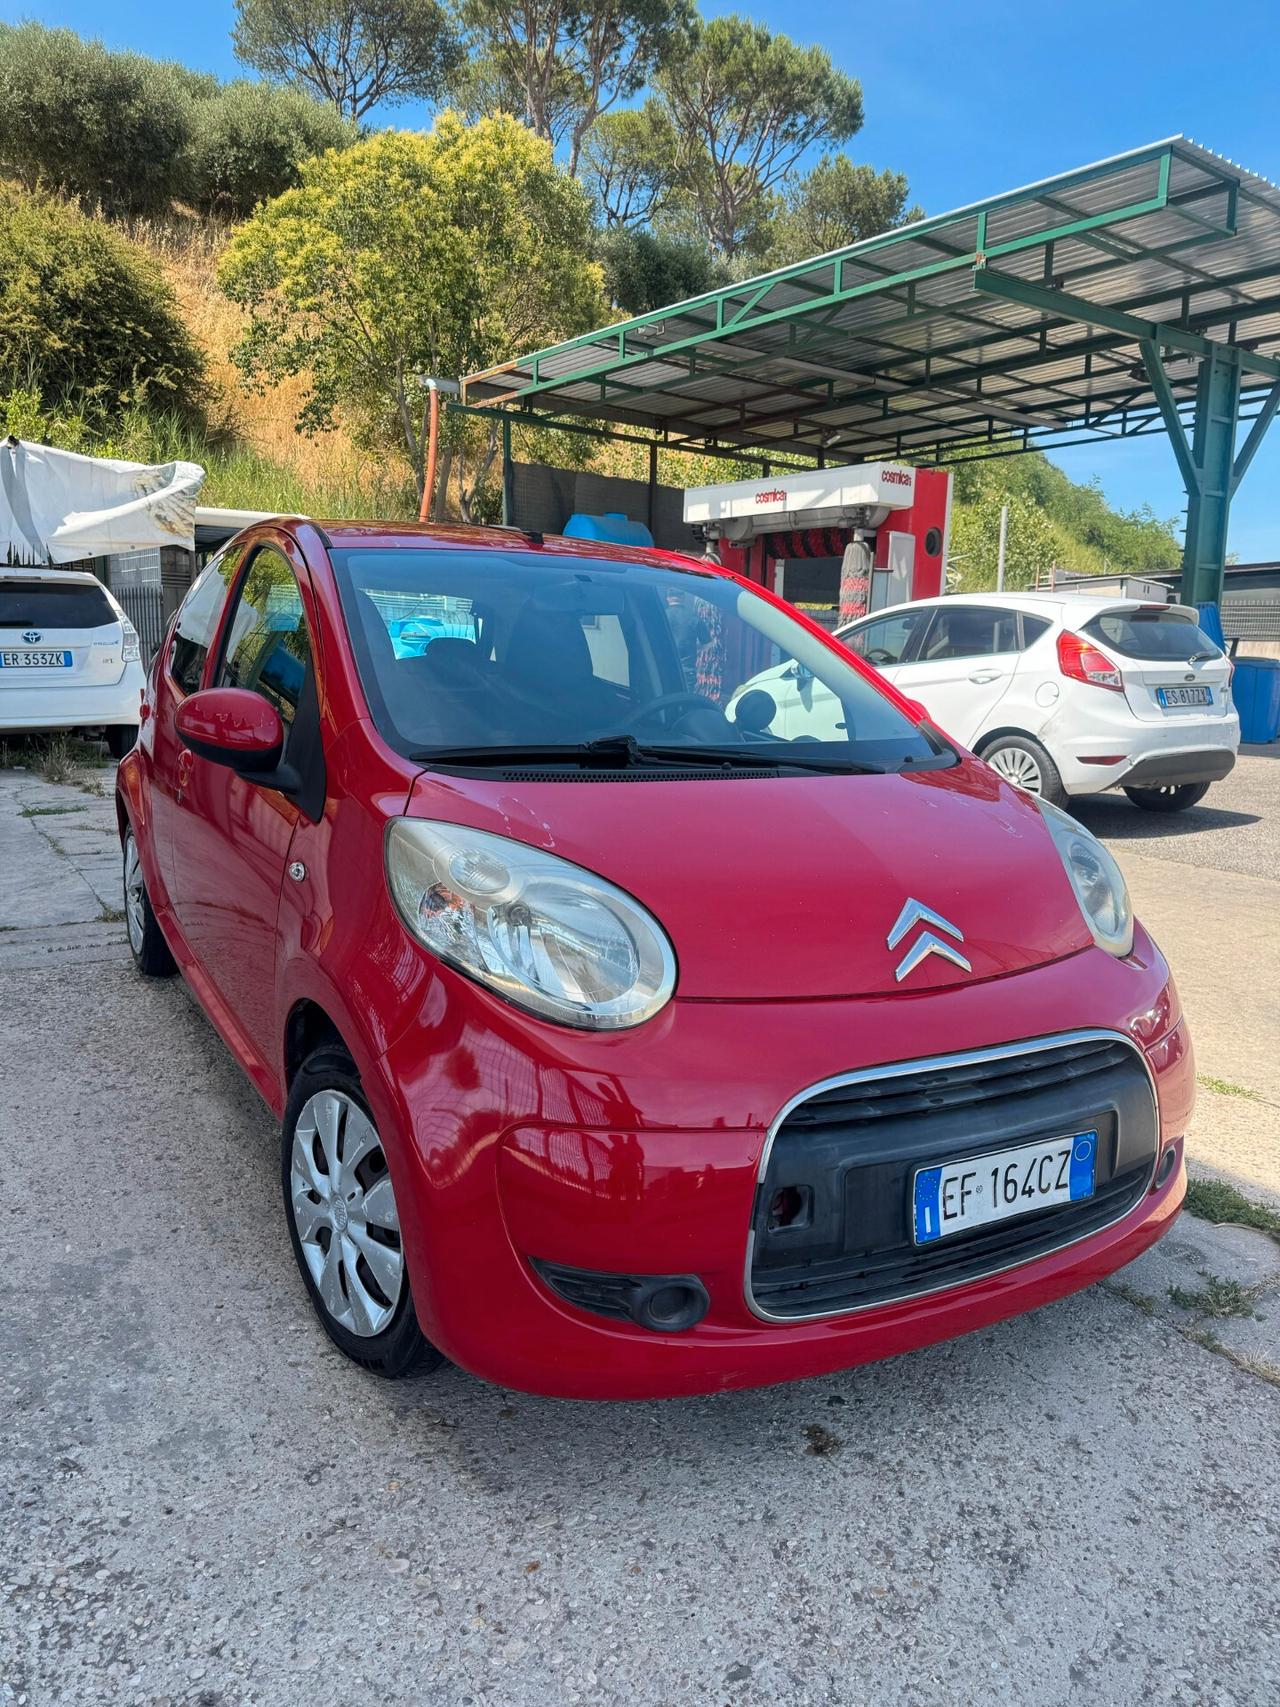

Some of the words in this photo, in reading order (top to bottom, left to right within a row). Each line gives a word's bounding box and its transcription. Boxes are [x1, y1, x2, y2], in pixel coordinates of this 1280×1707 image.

[3, 653, 19, 666] ER
[24, 653, 63, 665] 353ZK
[1164, 690, 1179, 705] ES
[942, 1172, 977, 1220] EF
[991, 1150, 1072, 1209] 164CZ
